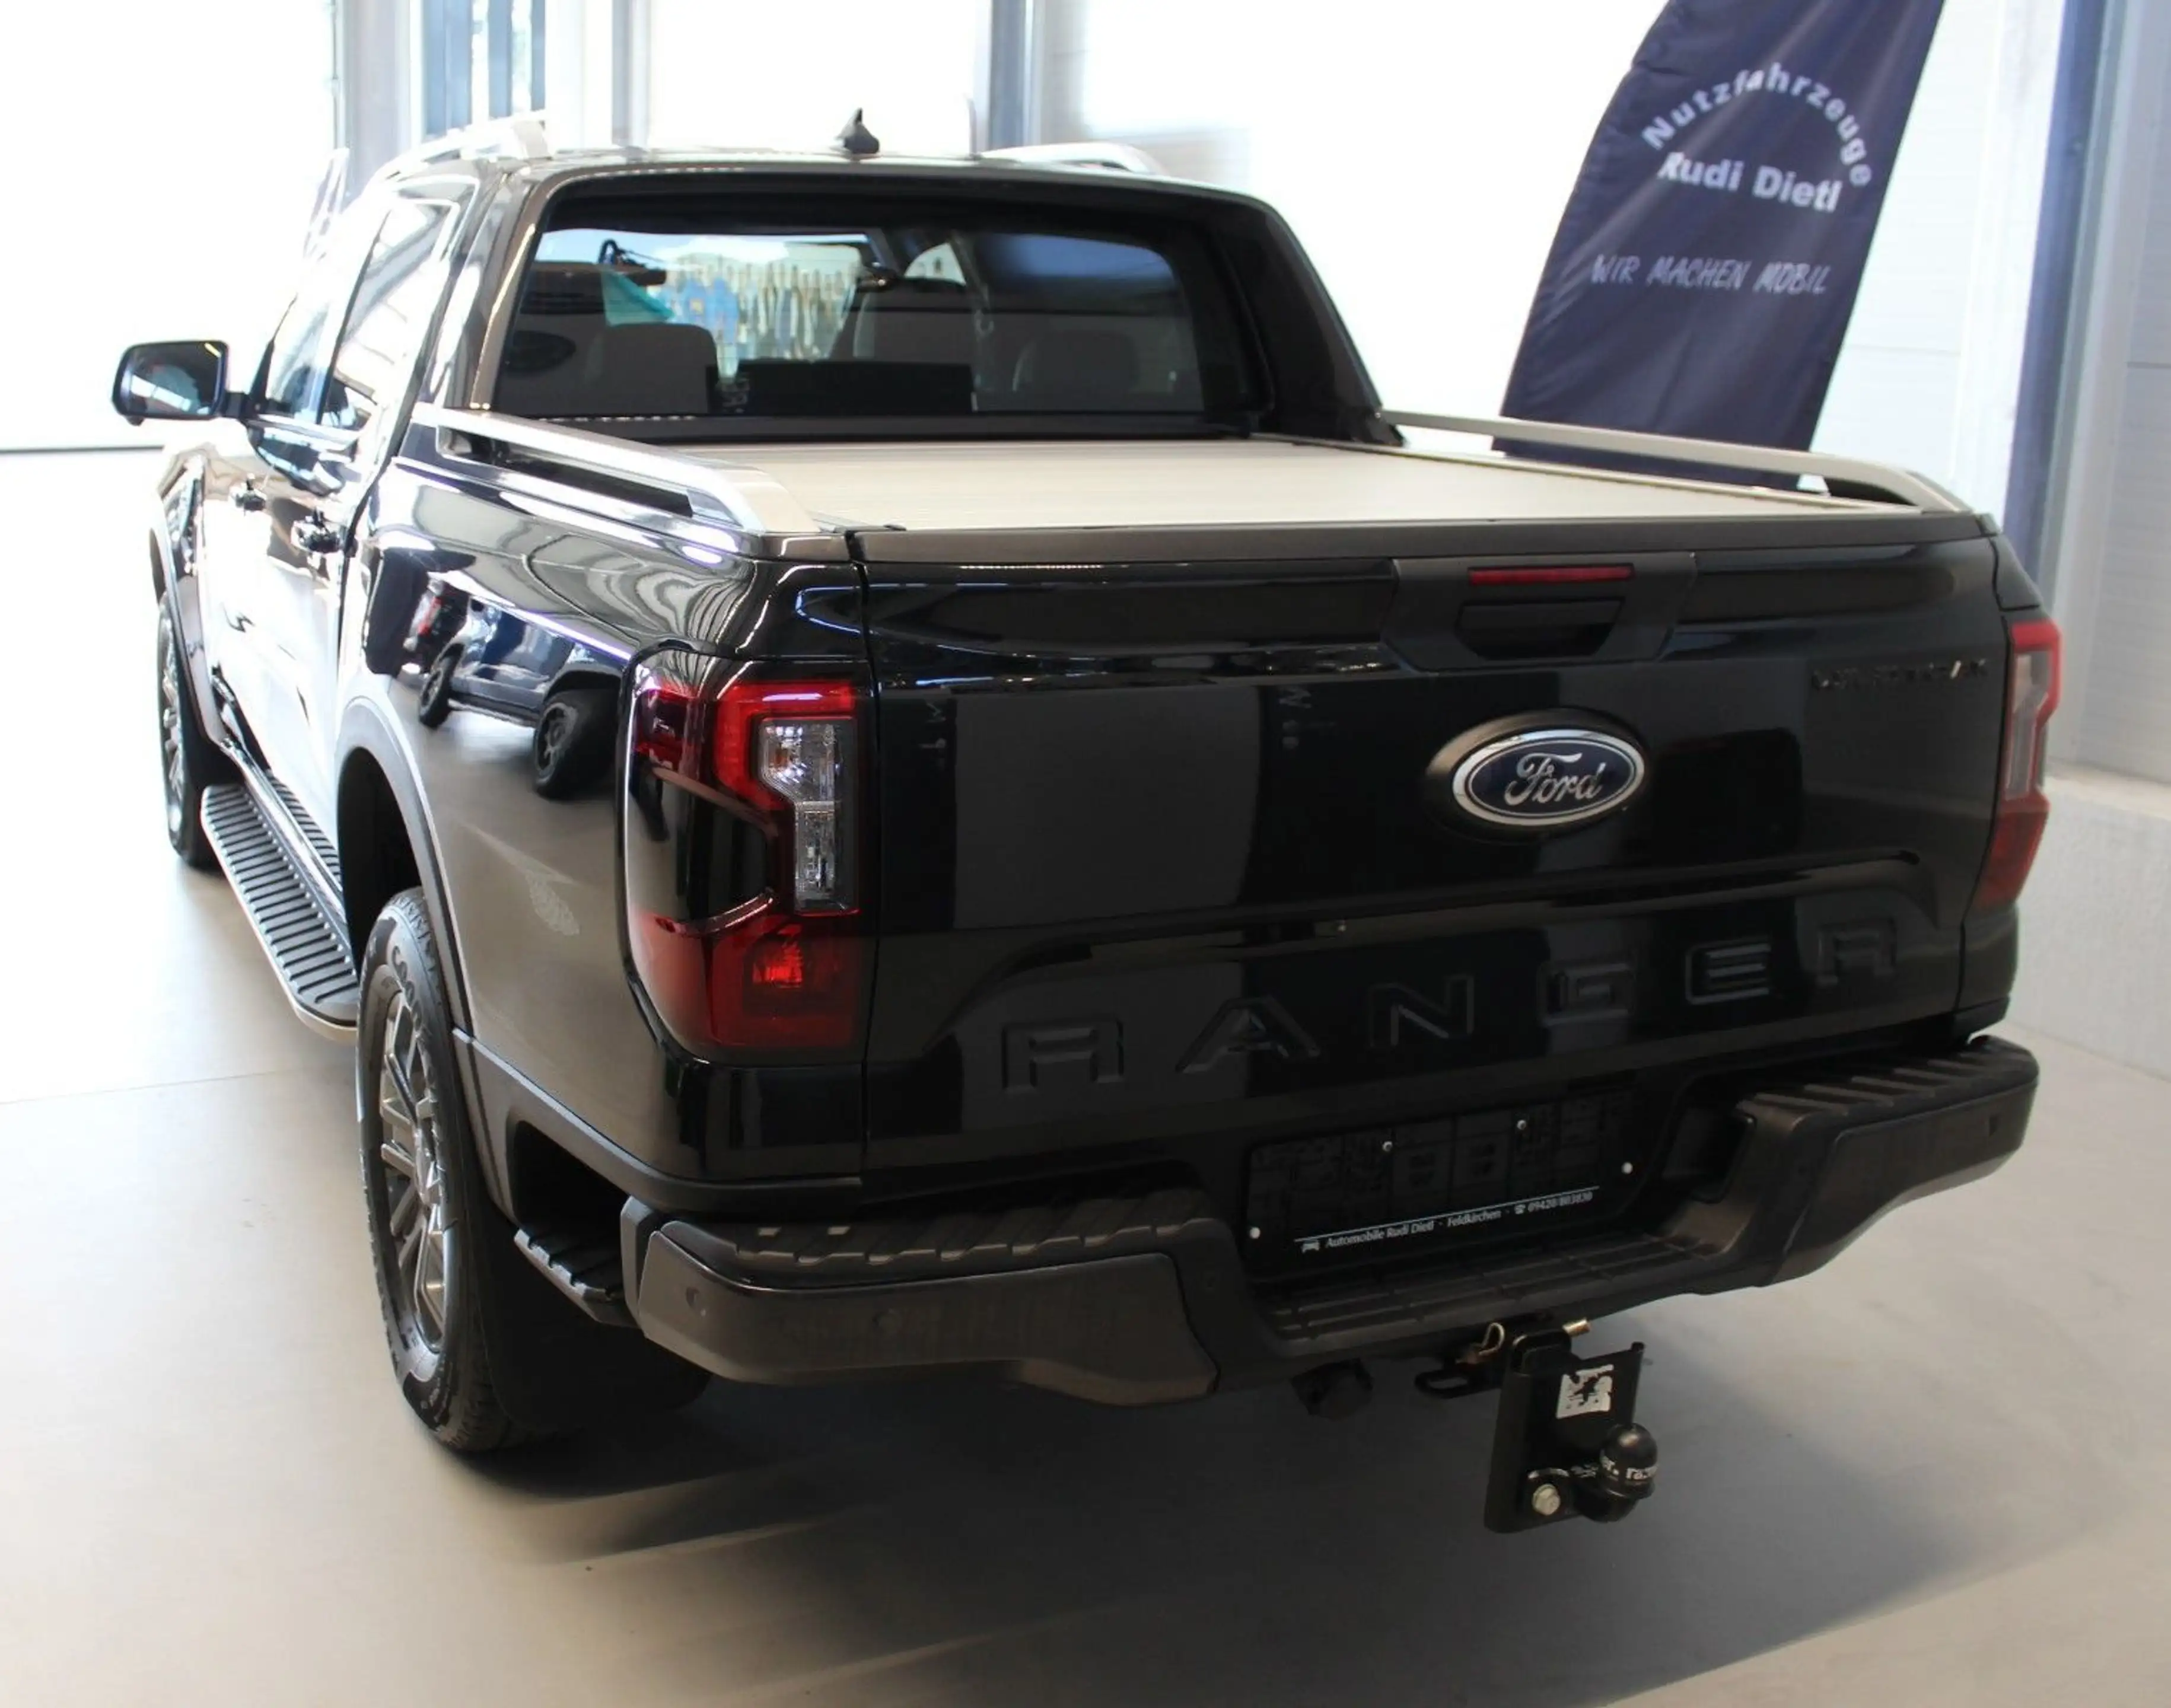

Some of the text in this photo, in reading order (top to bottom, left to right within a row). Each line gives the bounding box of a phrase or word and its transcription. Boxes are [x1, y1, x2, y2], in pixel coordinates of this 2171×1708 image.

[1642, 62, 1872, 187] Nutzfahrzeuge
[1657, 152, 1842, 213] Rudi Dietl
[1591, 254, 1831, 295] WIR MACHEN MOBIL
[1504, 753, 1605, 806] Ford
[1001, 919, 1896, 1094] RANGER
[1325, 1226, 1384, 1248] Automobile
[1386, 1223, 1409, 1238] Rudi
[1411, 1220, 1435, 1234] Dietl
[1447, 1208, 1501, 1228] Feldkirchen
